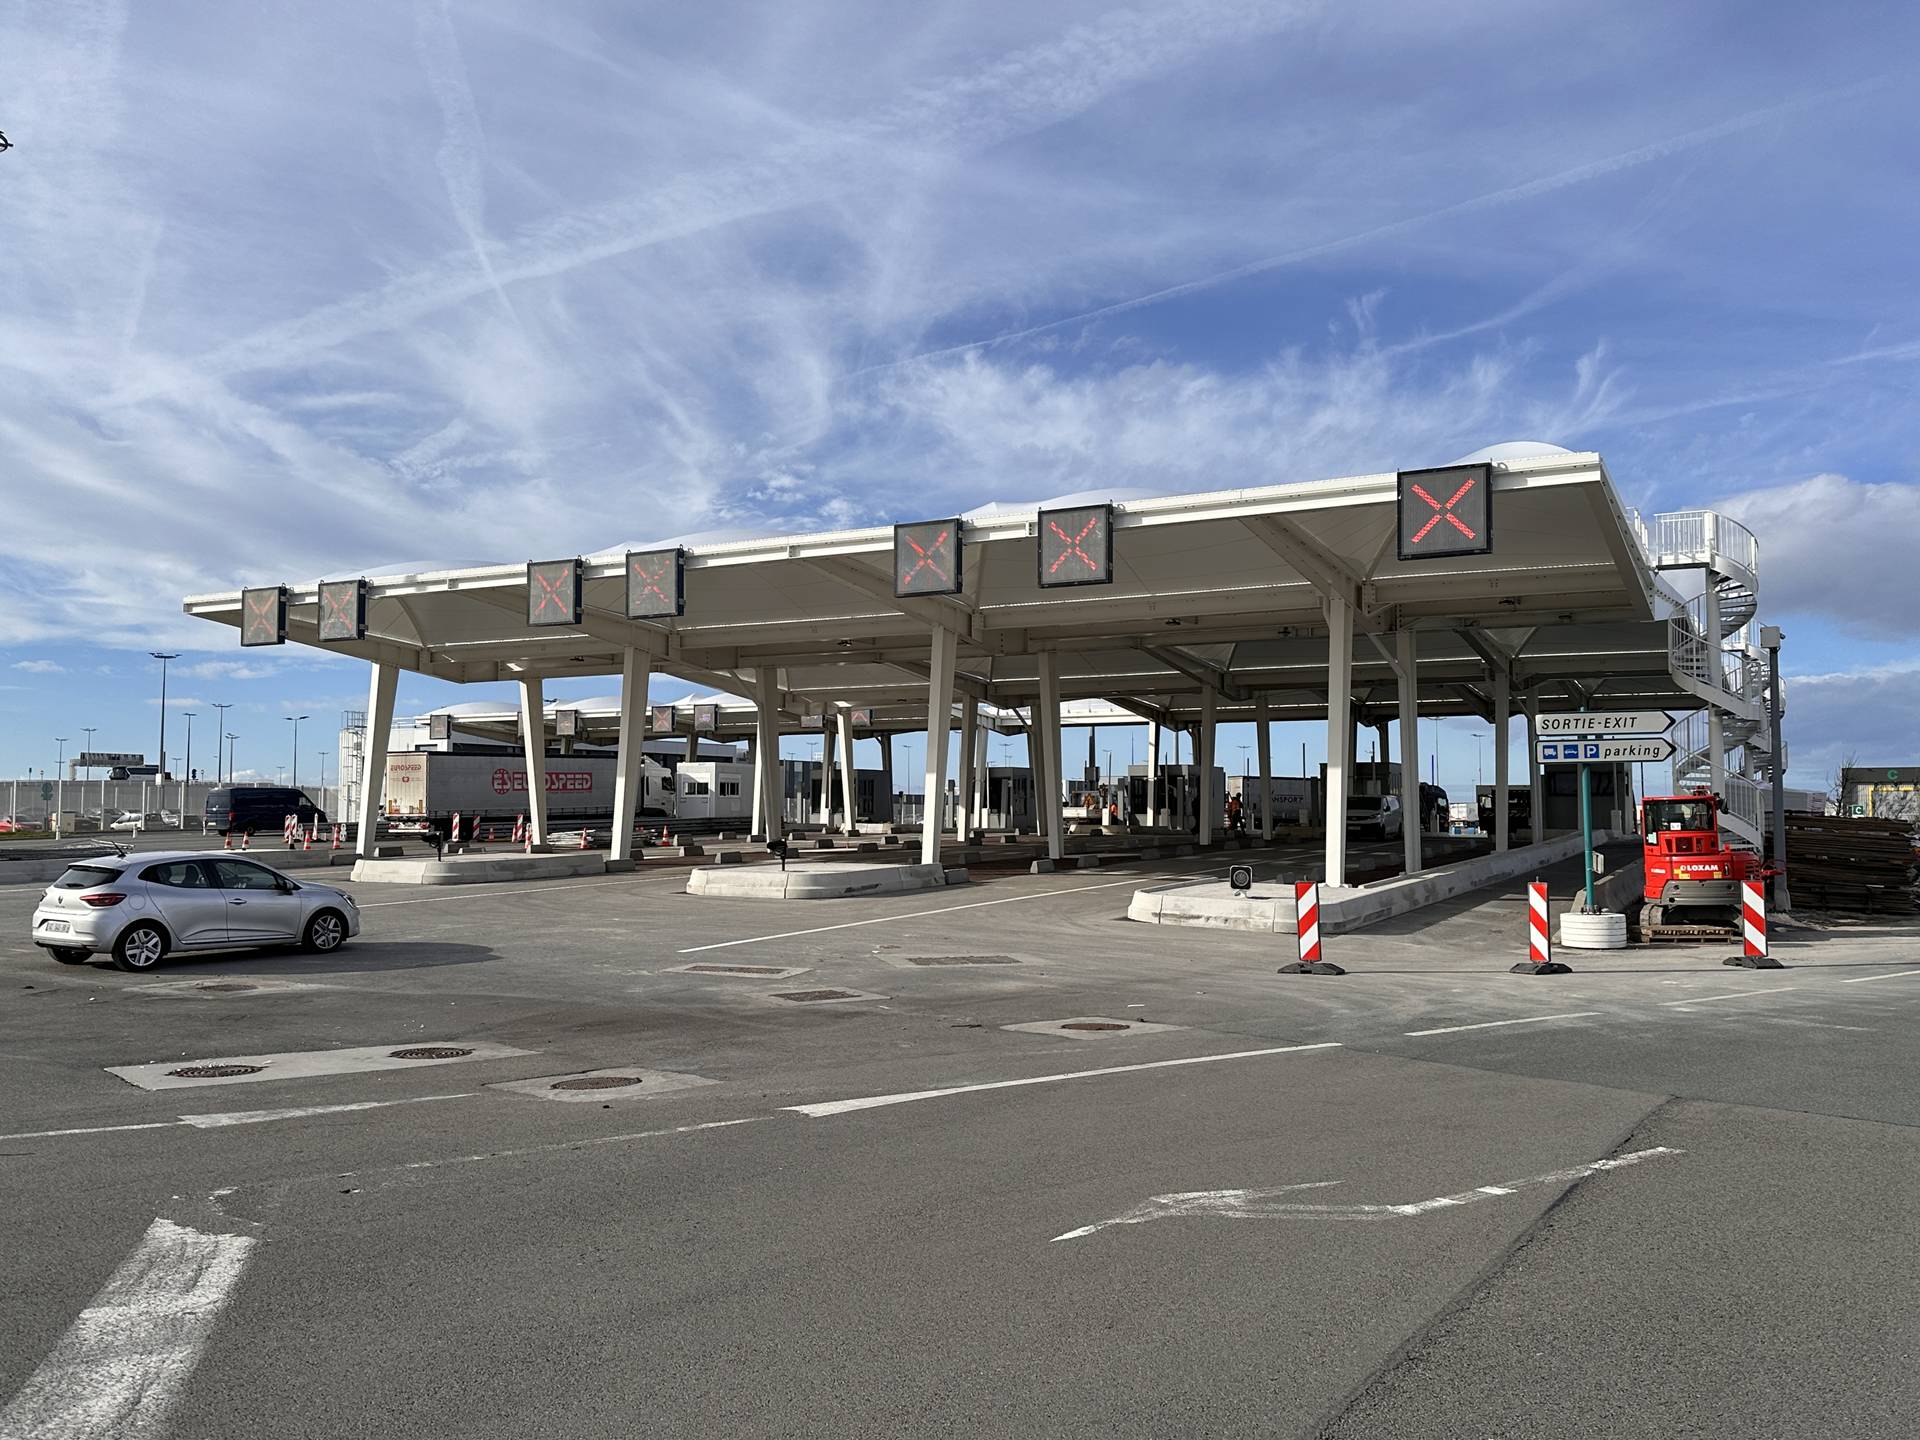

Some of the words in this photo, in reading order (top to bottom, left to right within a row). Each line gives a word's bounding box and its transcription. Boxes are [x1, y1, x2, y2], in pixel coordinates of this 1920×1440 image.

[1541, 716, 1638, 730] SORTIE-EXIT
[1586, 745, 1597, 758] P
[1604, 744, 1661, 758] parking
[1887, 769, 1898, 780] C
[1855, 806, 1862, 814] C
